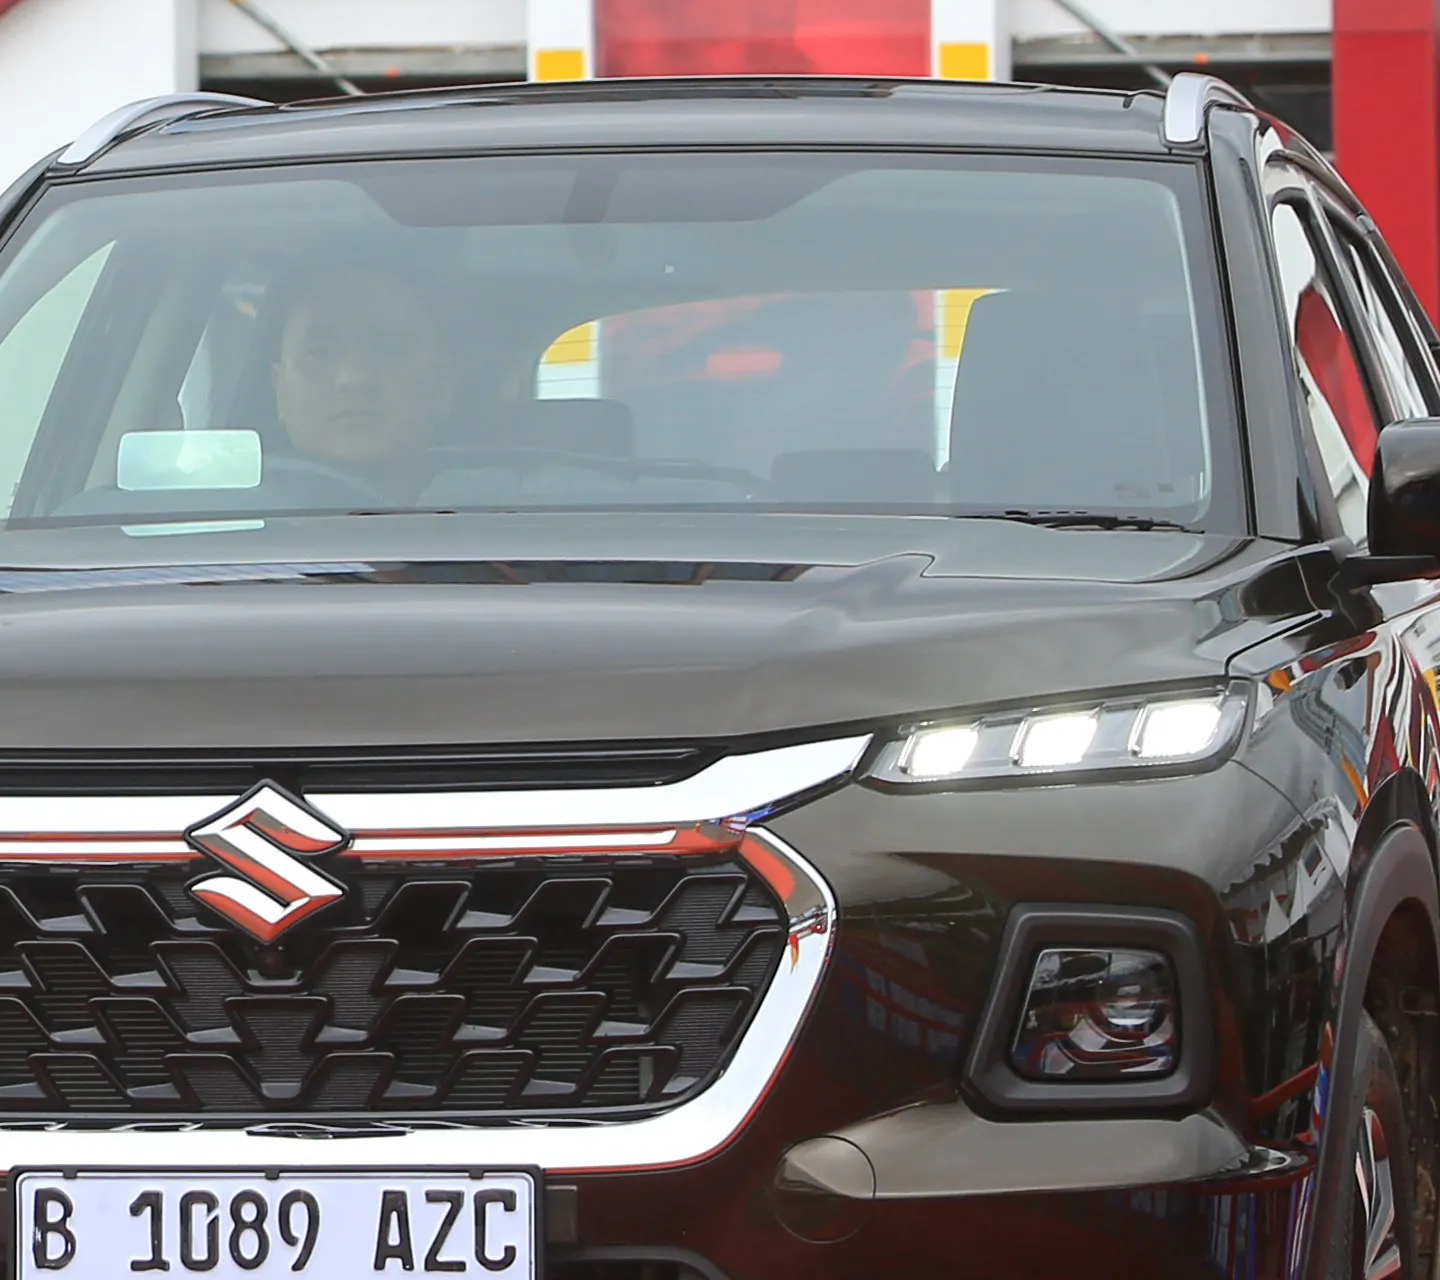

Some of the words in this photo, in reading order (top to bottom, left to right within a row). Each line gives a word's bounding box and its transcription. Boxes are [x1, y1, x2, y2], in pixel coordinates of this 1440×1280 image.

[32, 1188, 77, 1271] B
[129, 1188, 321, 1272] 1089
[372, 1188, 517, 1272] AZC
